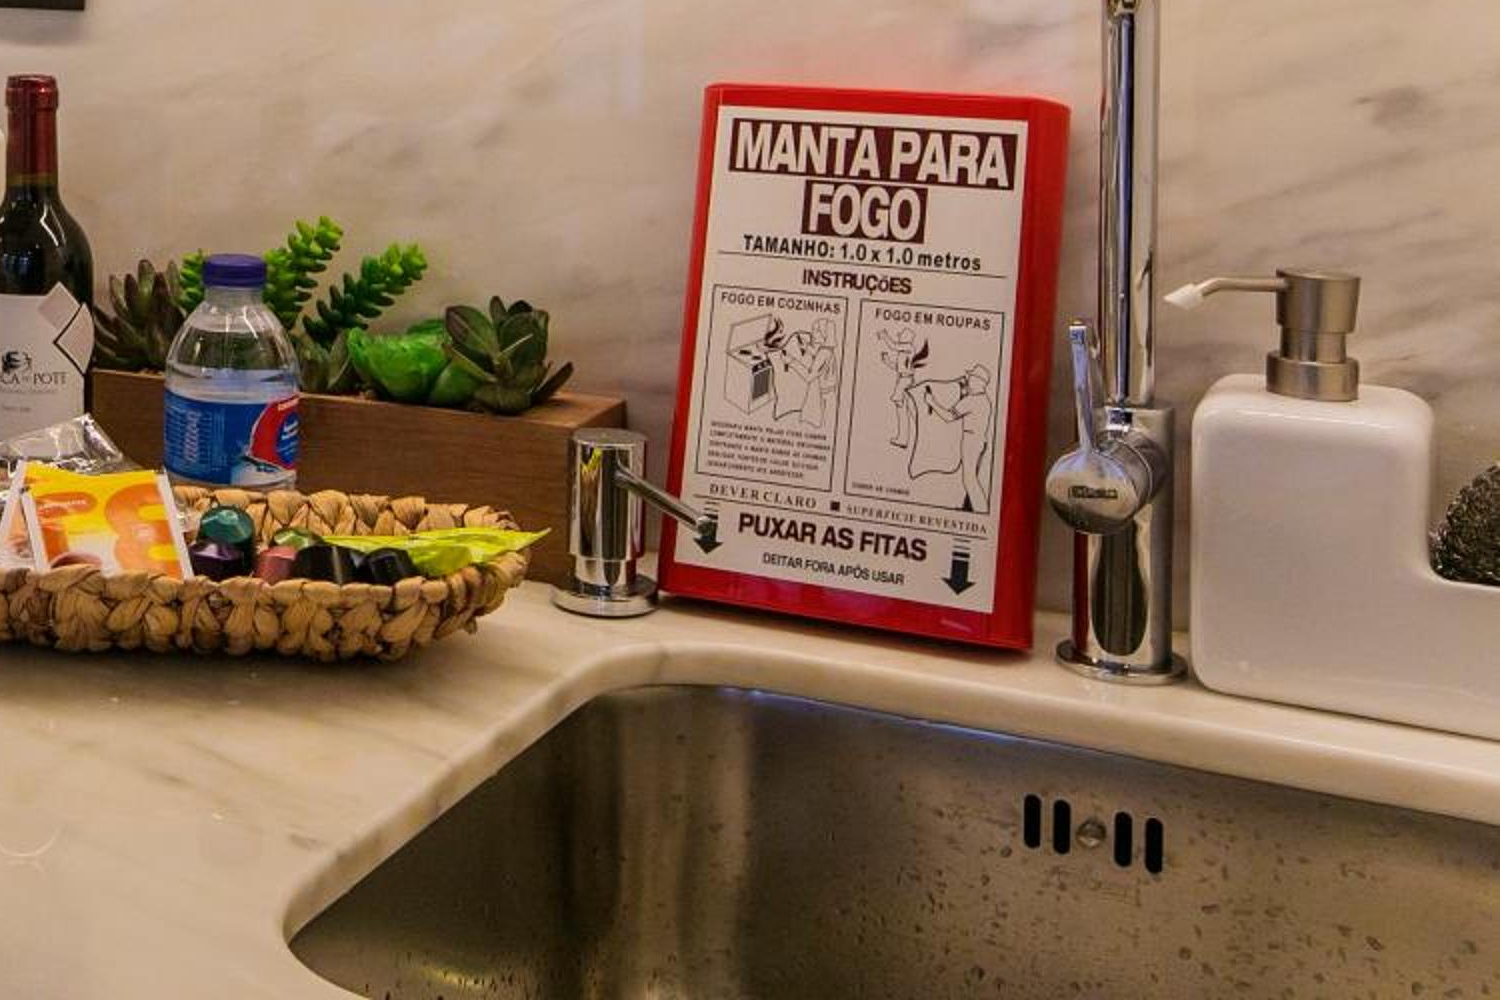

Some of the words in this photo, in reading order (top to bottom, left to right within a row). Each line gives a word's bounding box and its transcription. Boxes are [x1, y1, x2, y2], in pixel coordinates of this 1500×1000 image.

[735, 121, 881, 179] MANTA
[889, 130, 1009, 187] PARA
[808, 182, 921, 240] FOGO
[743, 234, 835, 258] TAMANHO:
[841, 243, 867, 261] 1.0
[887, 247, 913, 265] 1.0
[917, 252, 981, 271] metros
[721, 291, 755, 305] FOGO
[757, 295, 775, 307] EM
[777, 297, 841, 314] COZINHAS
[875, 307, 912, 323] FOGO
[914, 311, 933, 324] EM
[935, 313, 991, 331] ROUPAS
[738, 512, 817, 544] PUXAR
[821, 525, 854, 550] AS
[859, 531, 928, 562] FITAS
[919, 515, 987, 534] REVESTIDA
[762, 551, 803, 569] DEITAR
[804, 558, 835, 575] FORA
[871, 569, 905, 585] USAR
